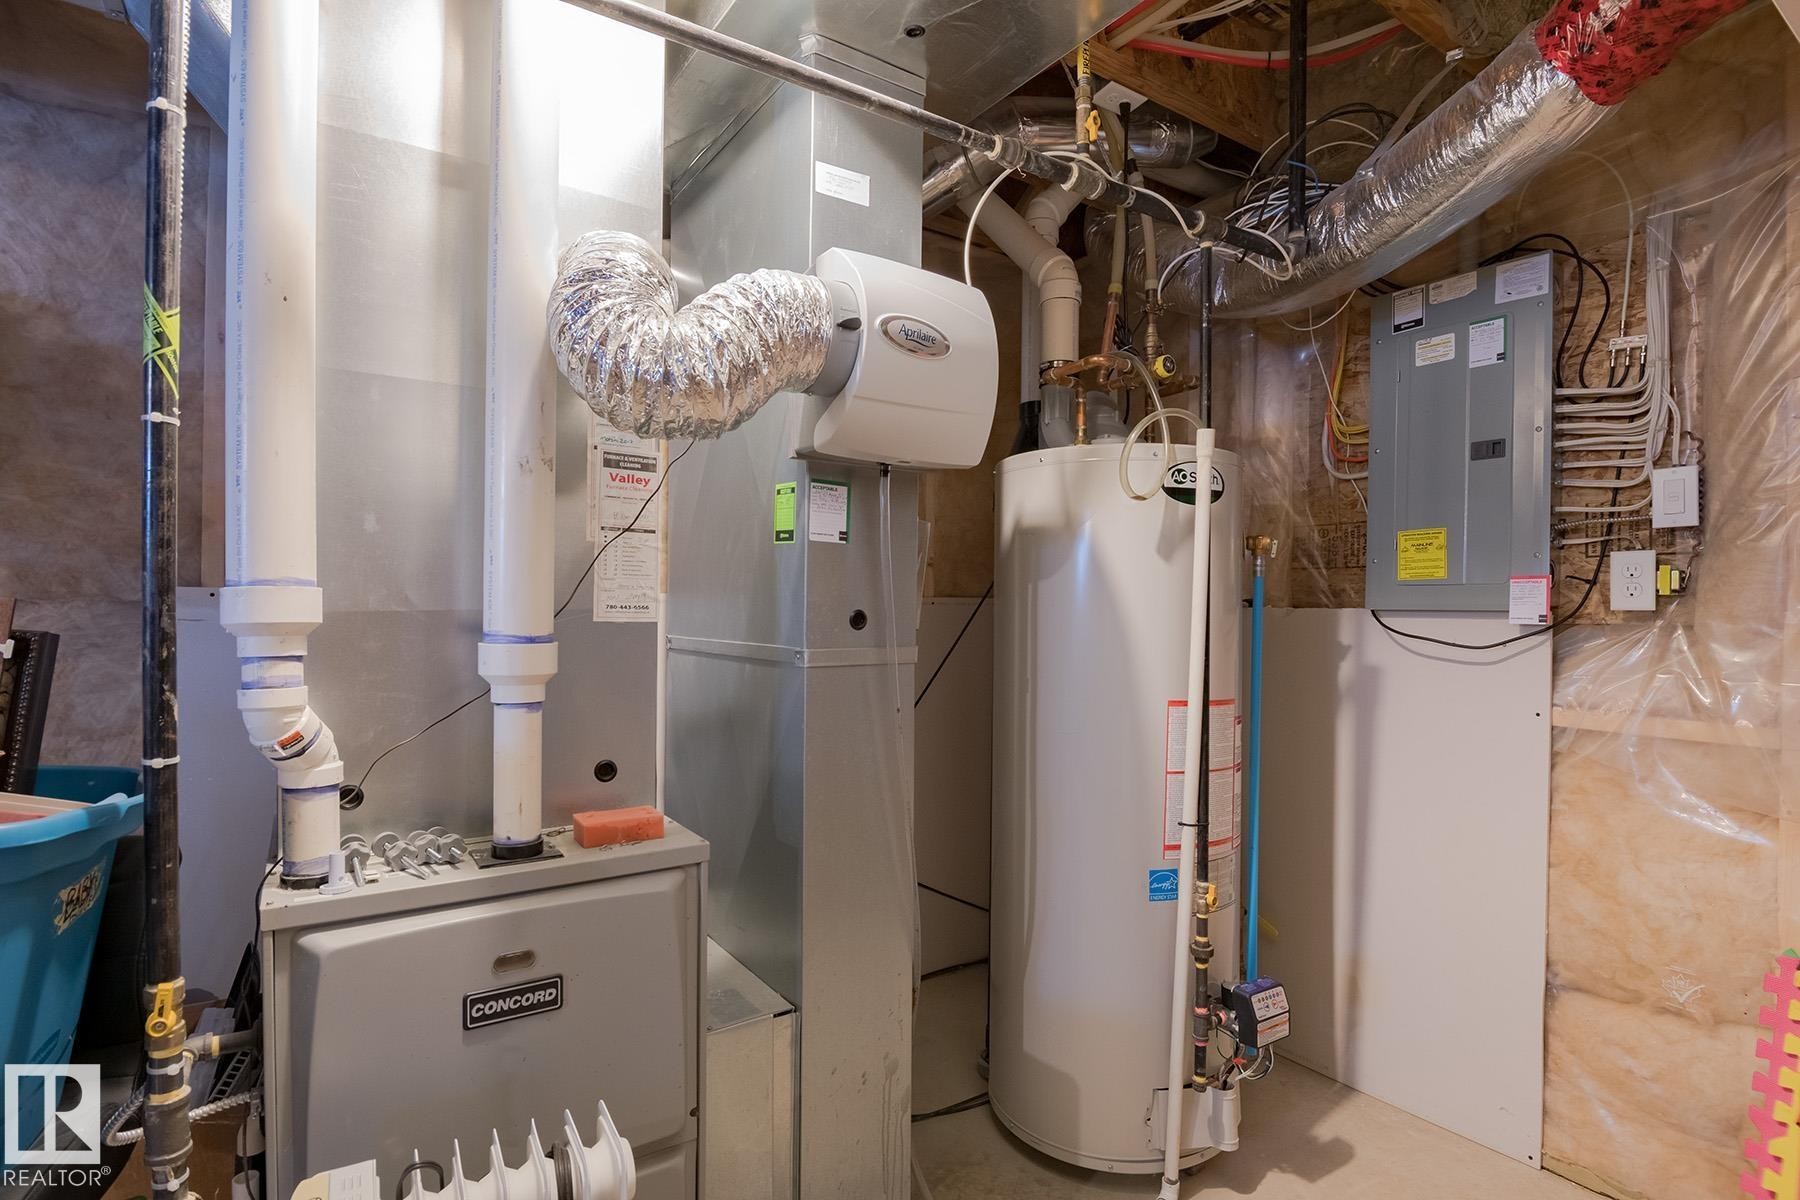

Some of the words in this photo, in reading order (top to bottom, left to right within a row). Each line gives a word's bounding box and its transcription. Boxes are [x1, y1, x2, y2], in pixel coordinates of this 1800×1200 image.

[898, 323, 937, 345] Aprilaire
[609, 471, 651, 487] Valley
[471, 988, 557, 1018] CONCORD
